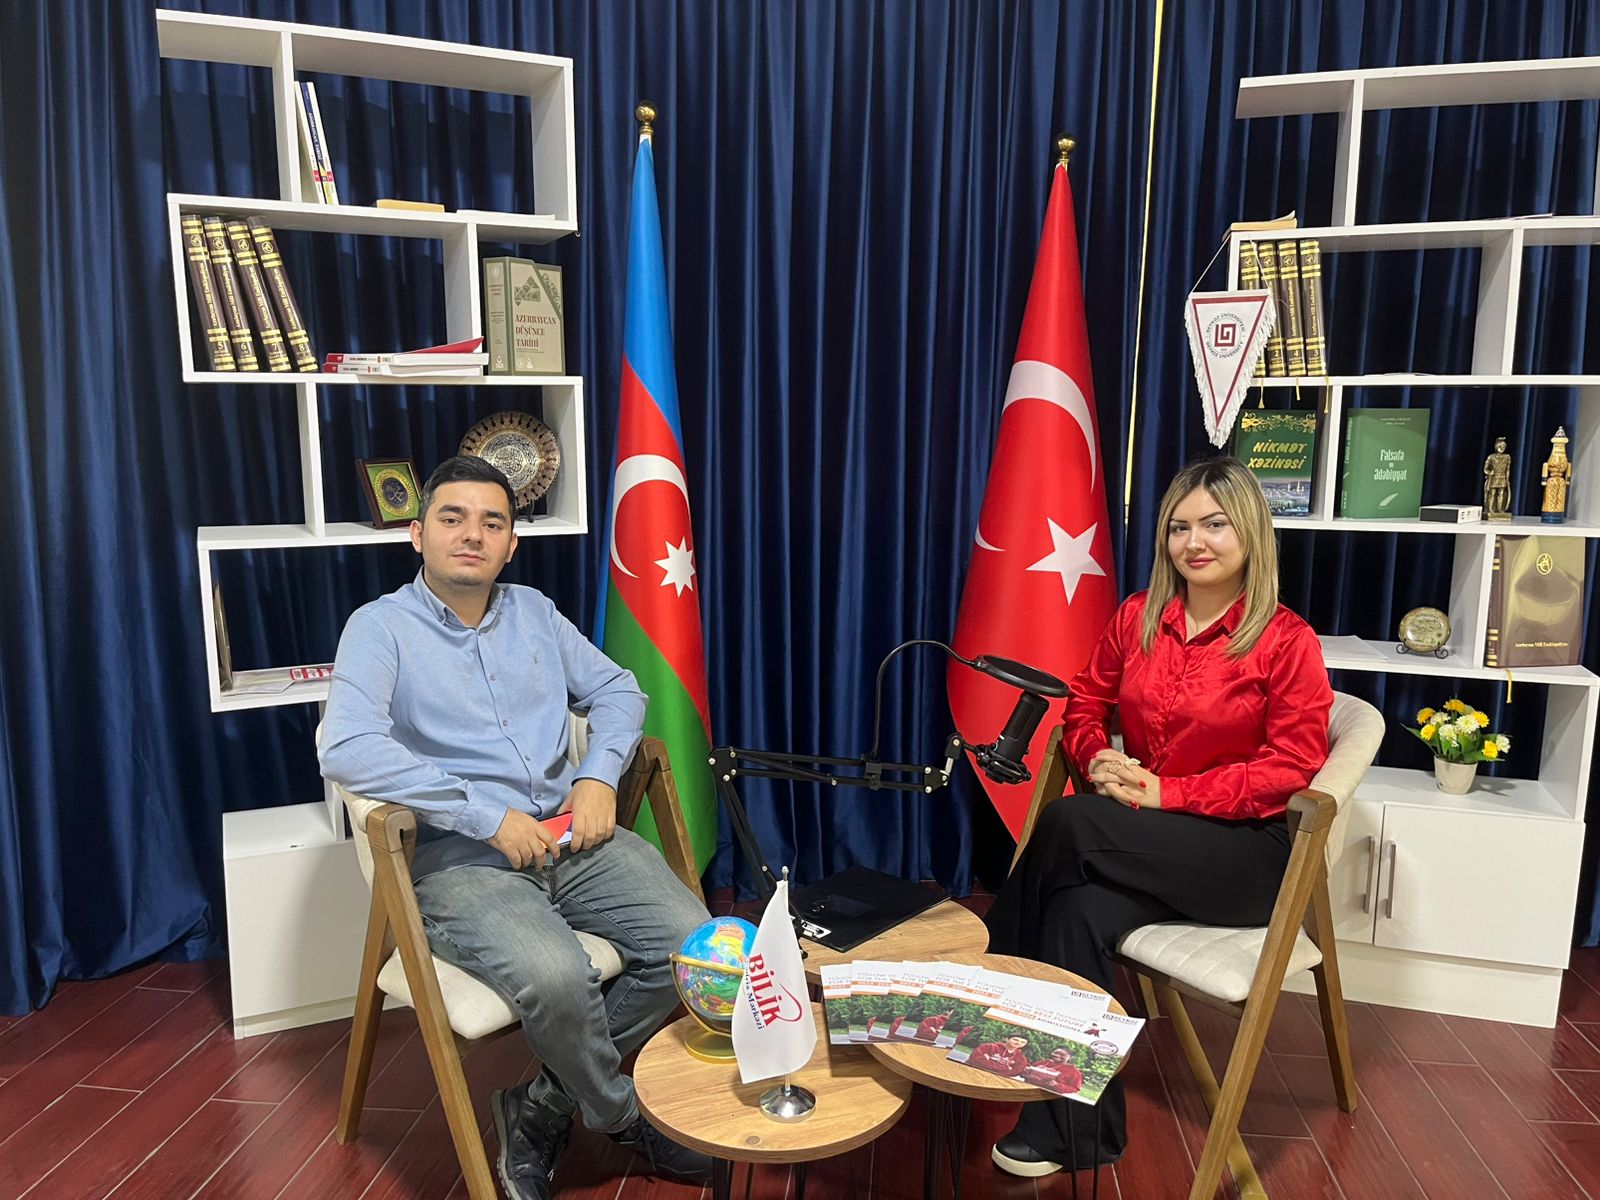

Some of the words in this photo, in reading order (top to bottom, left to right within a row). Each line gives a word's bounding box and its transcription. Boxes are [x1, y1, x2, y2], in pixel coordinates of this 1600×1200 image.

[218, 341, 224, 350] 5
[272, 342, 278, 350] 7
[299, 343, 305, 352] 8
[749, 953, 782, 1027] BİLİK
[747, 992, 765, 1030] Mərkəzi
